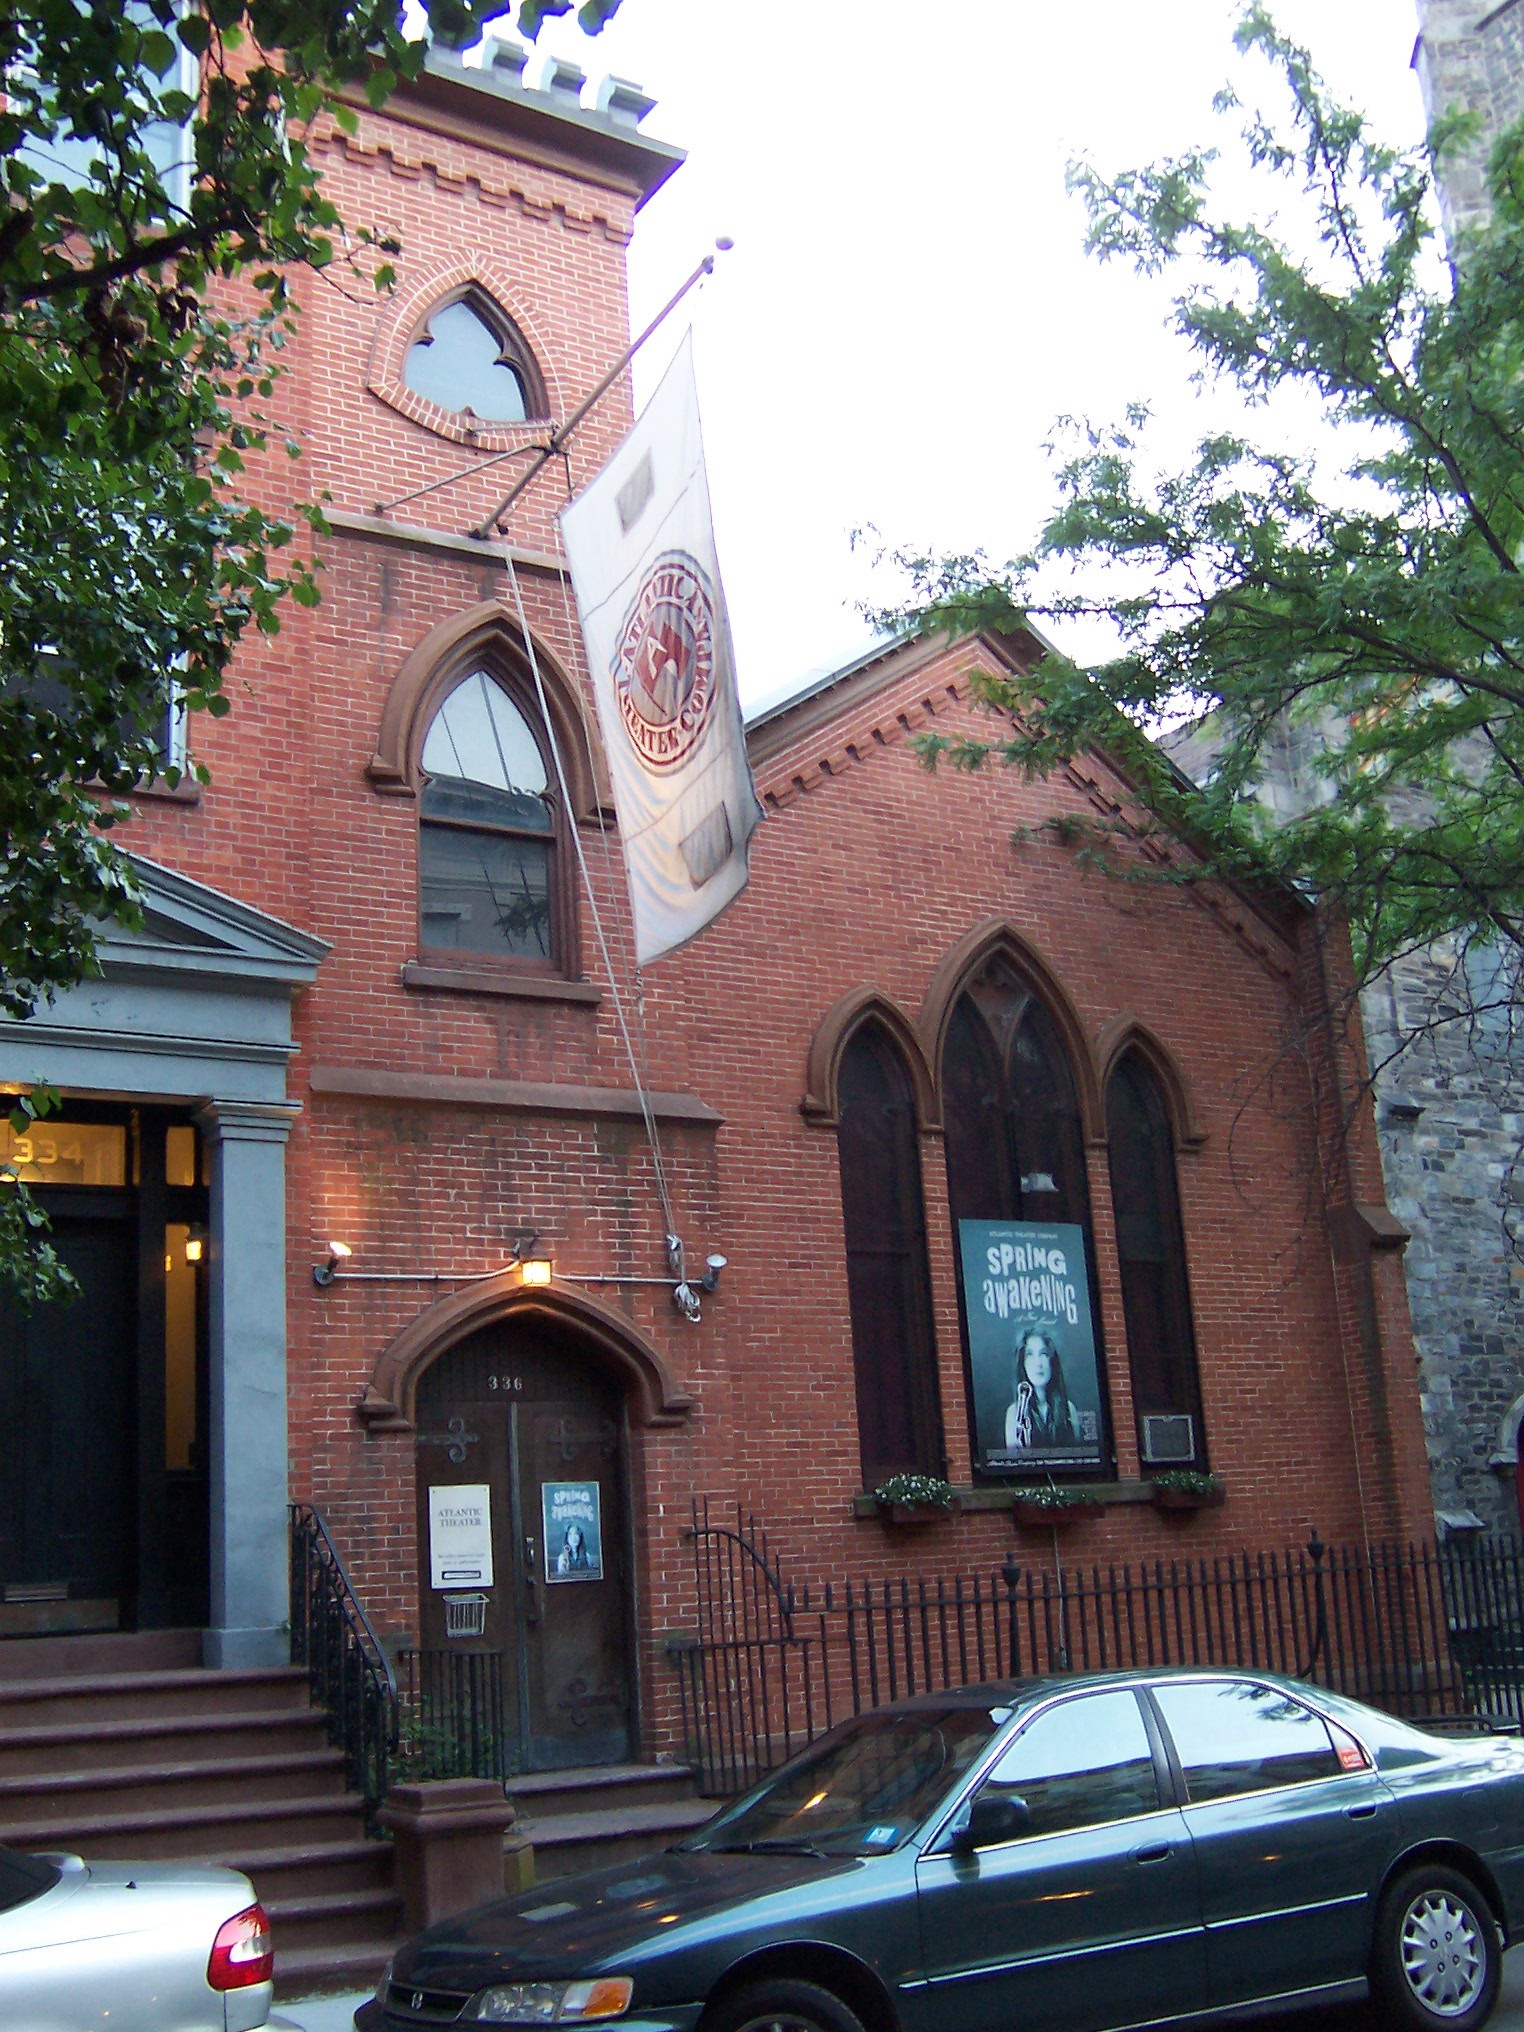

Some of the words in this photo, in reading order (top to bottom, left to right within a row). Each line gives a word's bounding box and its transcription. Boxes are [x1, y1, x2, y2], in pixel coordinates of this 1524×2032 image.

[12, 1136, 84, 1165] 334
[986, 1241, 1067, 1277] SPRING
[488, 1375, 522, 1391] 336
[437, 1507, 482, 1518] ATLANTIC
[440, 1518, 482, 1528] THEATER
